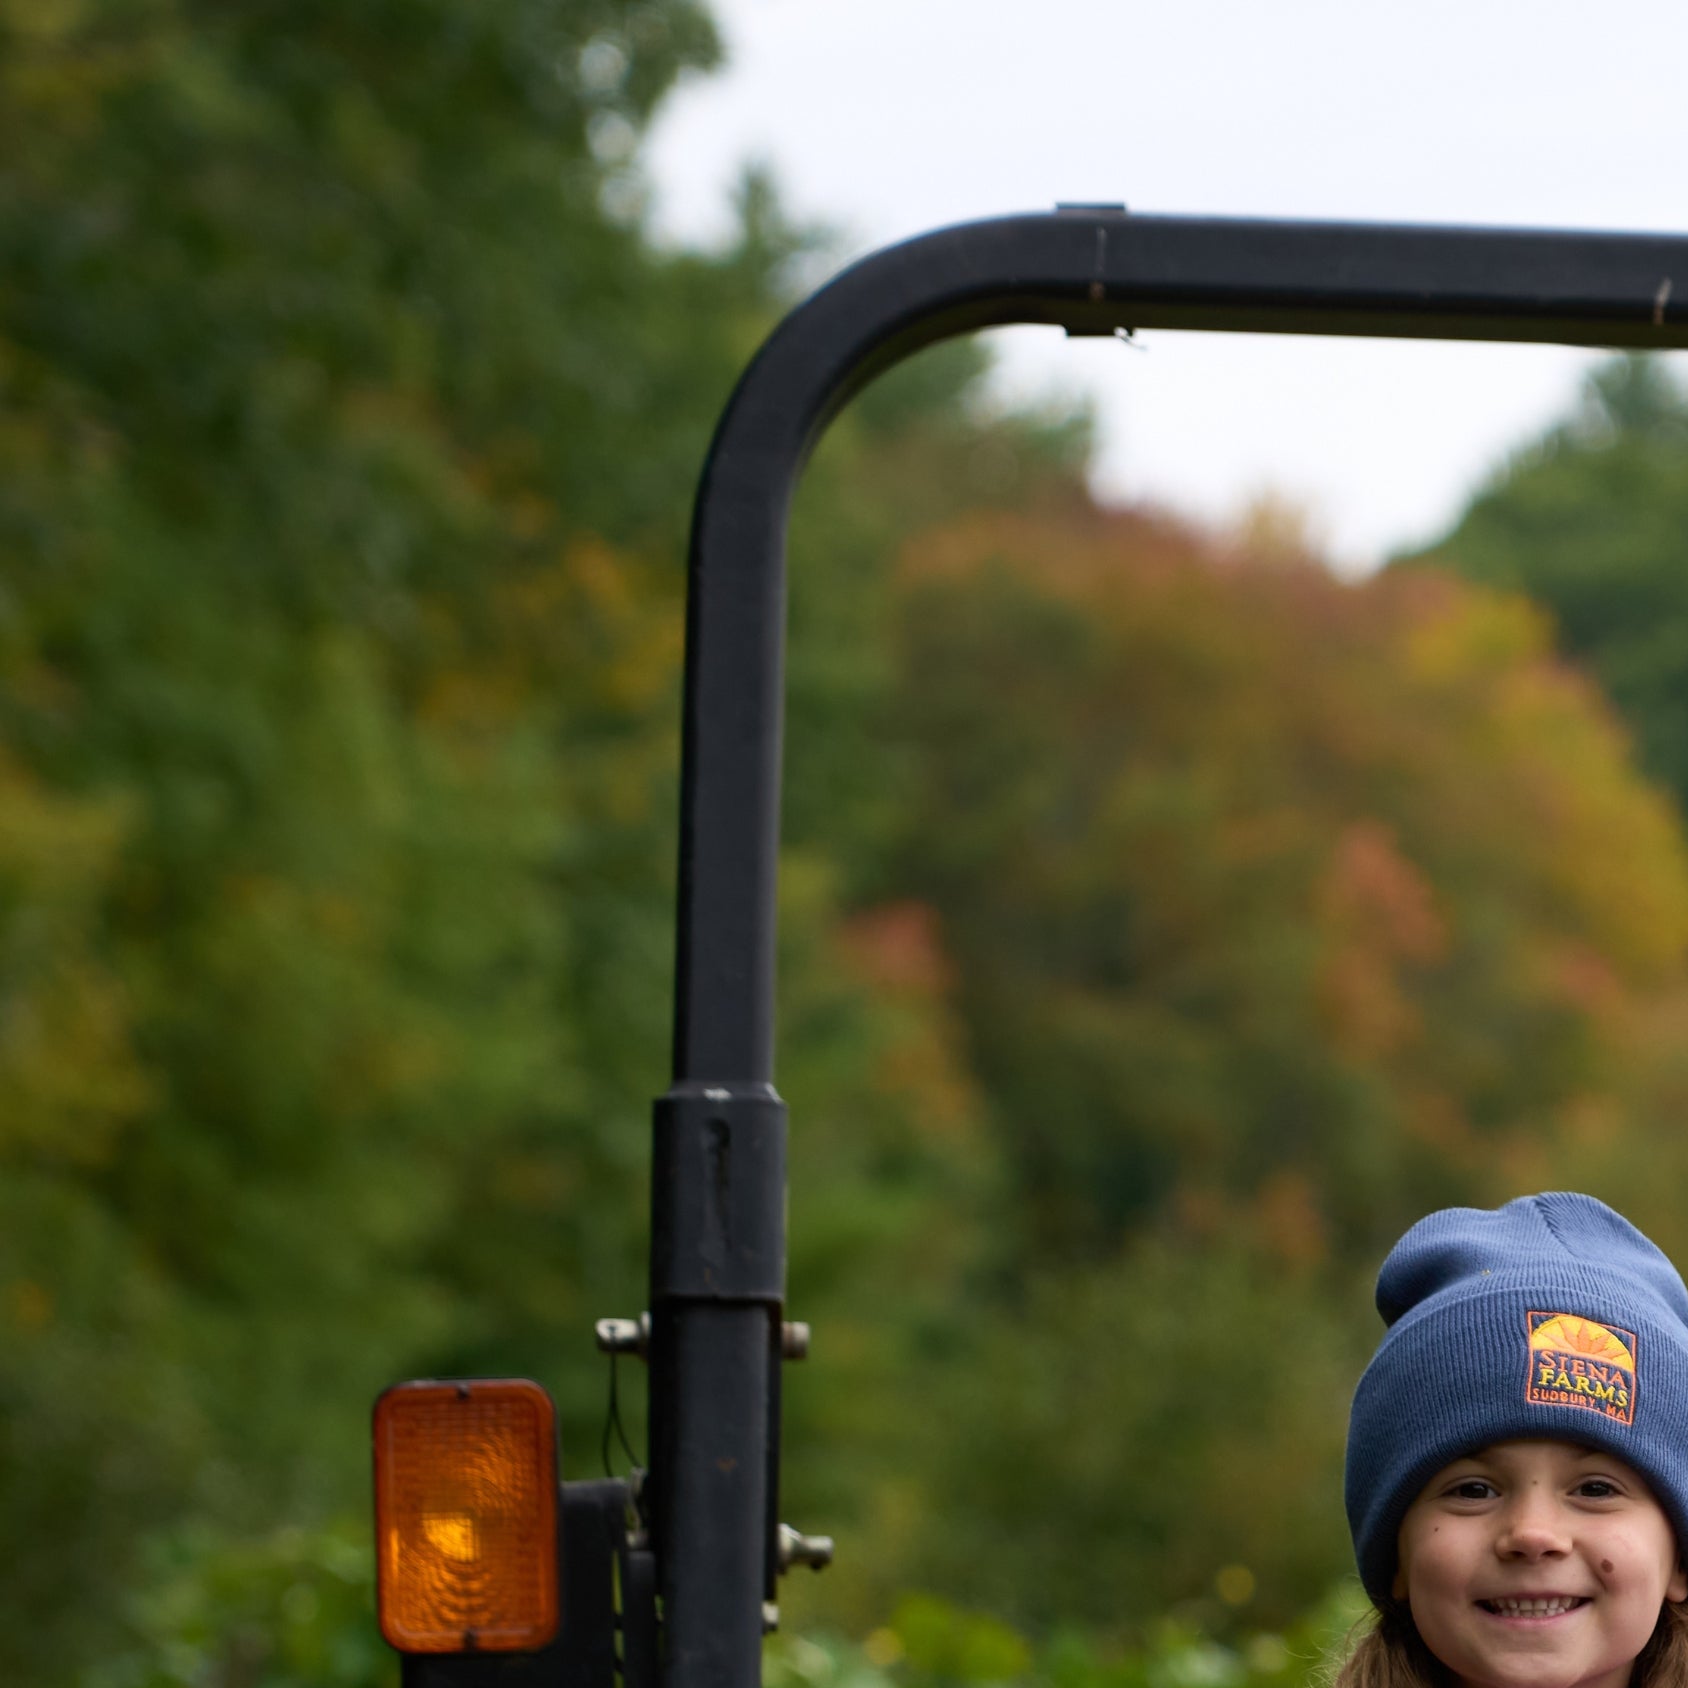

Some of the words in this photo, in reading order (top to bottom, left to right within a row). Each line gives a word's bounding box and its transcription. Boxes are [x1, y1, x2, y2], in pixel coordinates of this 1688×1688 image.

[1538, 1350, 1628, 1390] SIENA
[1538, 1368, 1628, 1407] FARMS
[1606, 1403, 1626, 1420] MA
